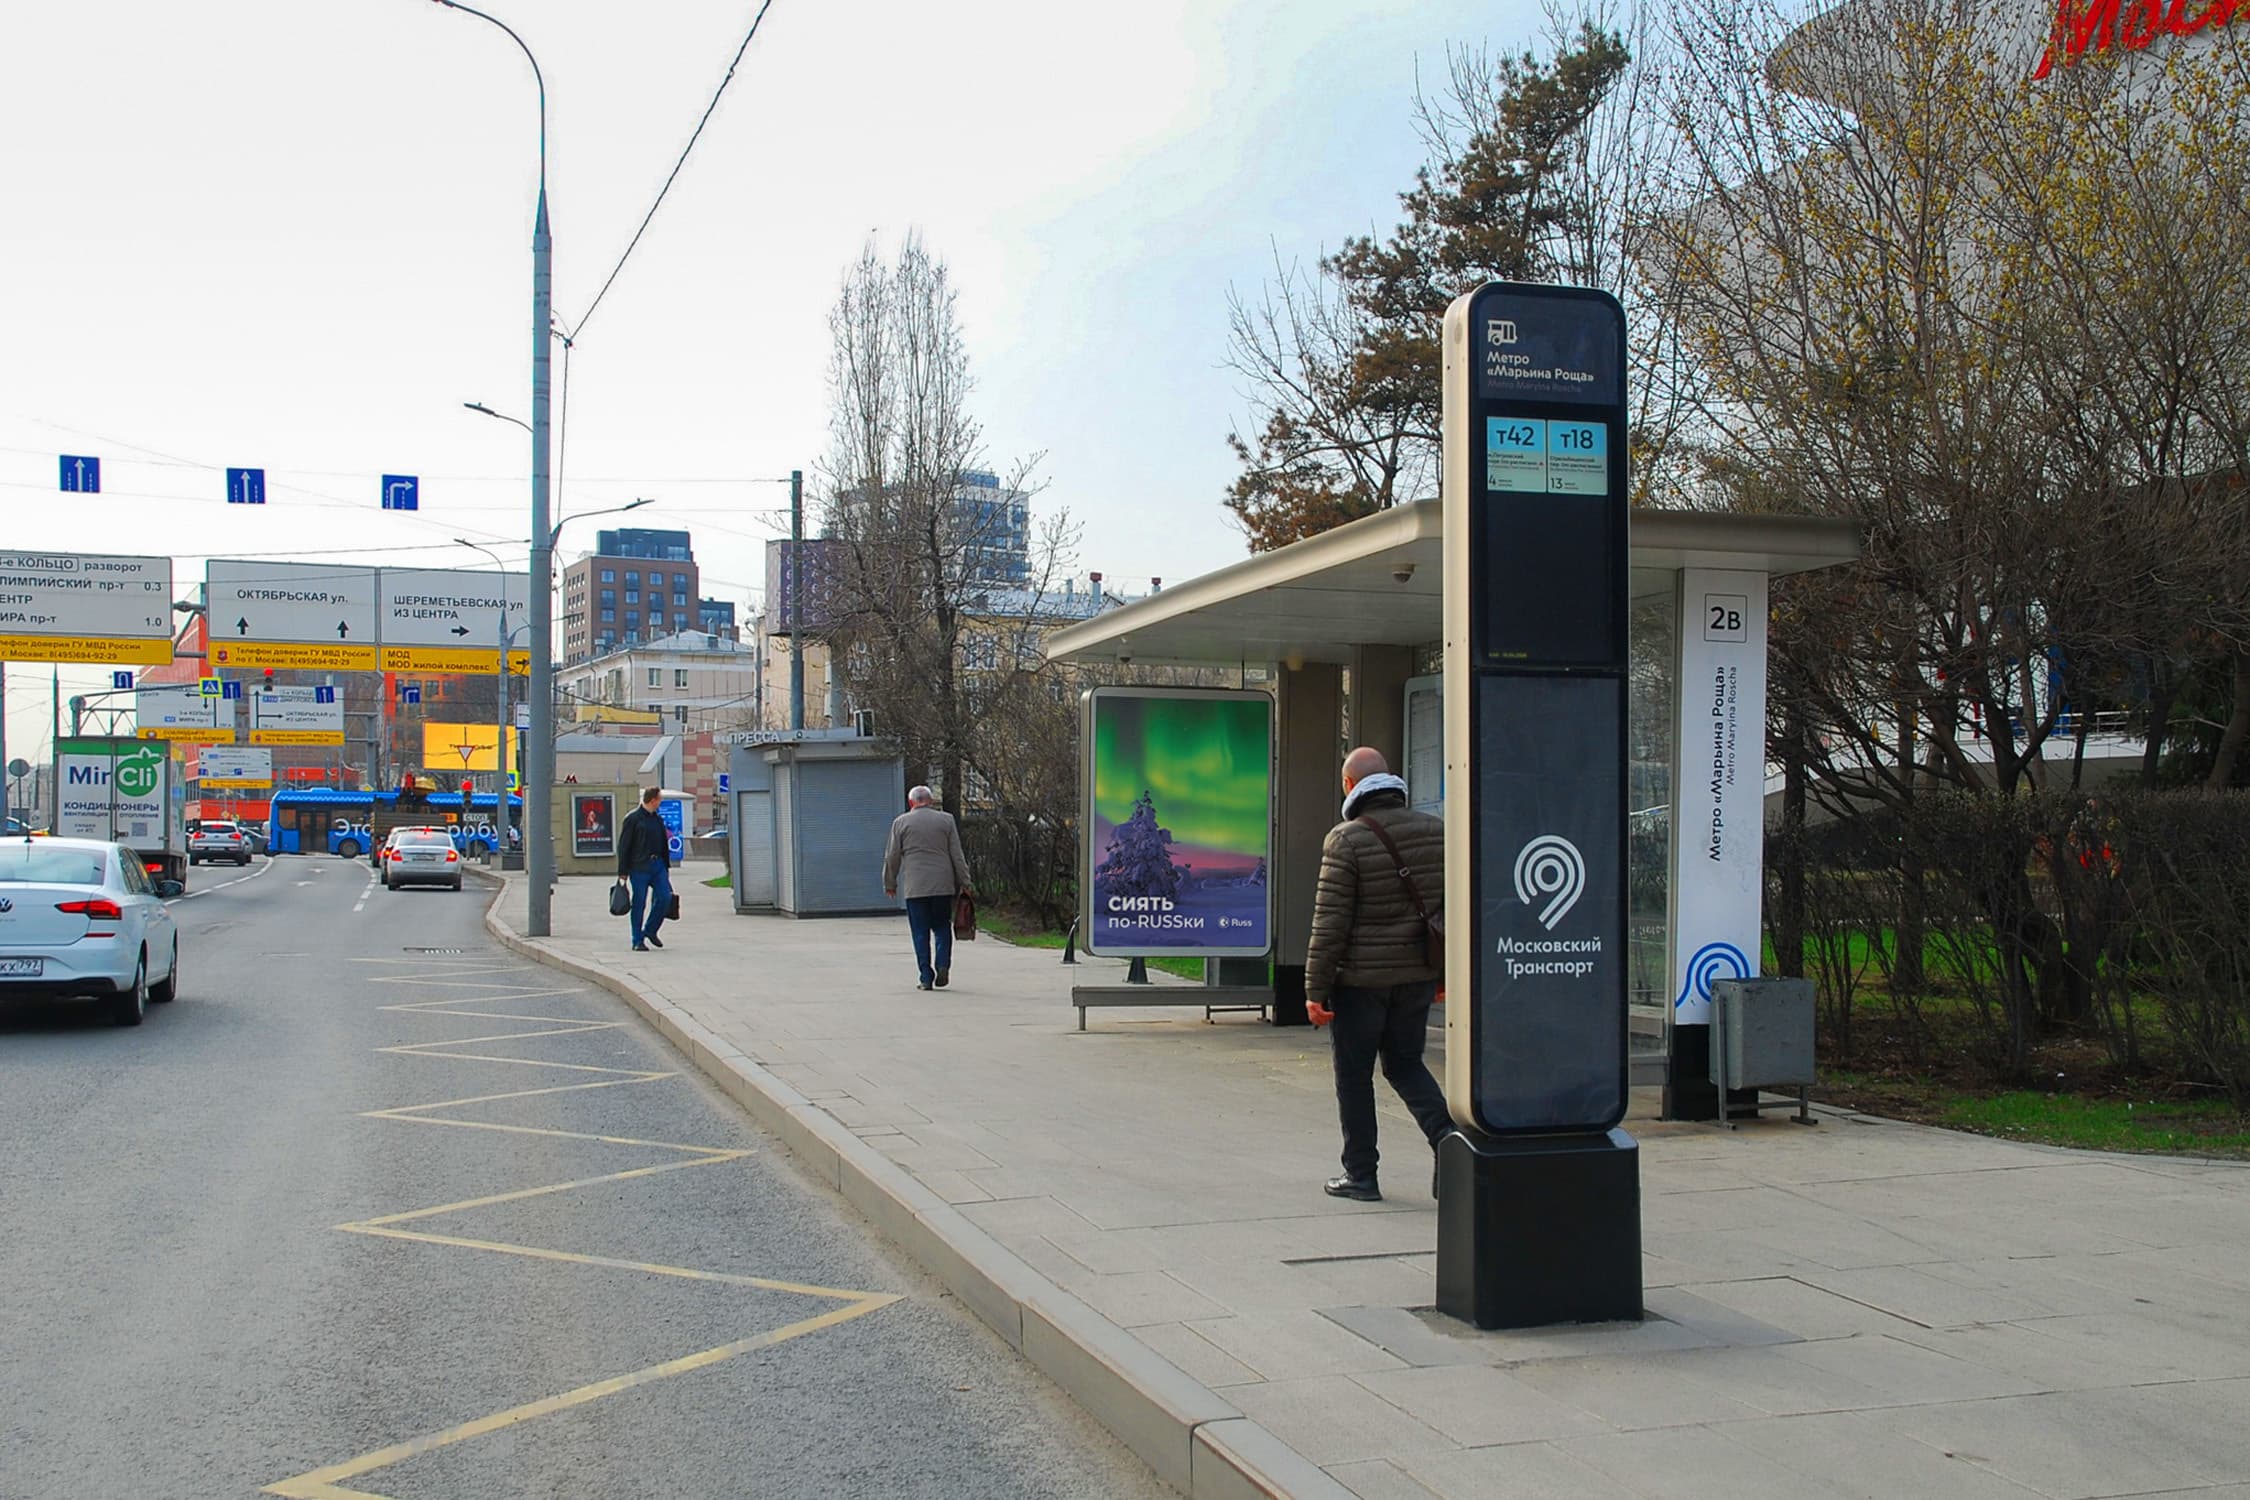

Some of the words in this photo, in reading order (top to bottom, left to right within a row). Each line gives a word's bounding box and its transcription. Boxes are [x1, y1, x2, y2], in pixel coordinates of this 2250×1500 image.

[1487, 351, 1530, 366] Метро
[1487, 364, 1552, 380] «Марьина
[1554, 368, 1594, 383] Роща»
[1488, 475, 1496, 486] 4
[1550, 478, 1563, 489] 13
[18, 557, 74, 571] КОЛЬЦО
[84, 562, 142, 573] разворот
[99, 582, 125, 592] пр-т
[144, 582, 162, 592] 0.3
[237, 589, 328, 602] ОКТЯБРЬСКАЯ
[331, 594, 349, 604] ул.
[394, 595, 507, 609] ШЕРЕМЕТЬЕВСКАЯ
[30, 615, 57, 625] пр-т
[394, 609, 409, 618] ИЗ
[412, 609, 459, 619] ЦЕНТРА
[145, 617, 162, 627] 1.0
[31, 641, 70, 650] доверия
[72, 641, 83, 650] ГУ
[86, 641, 106, 651] МВД
[108, 641, 141, 650] России
[236, 647, 272, 656] Телефон
[273, 648, 308, 657] доверия
[310, 649, 320, 657] ГУ
[322, 649, 341, 658] МВД
[342, 650, 371, 658] России
[10, 649, 46, 658] Москве:
[387, 650, 411, 659] МОД
[412, 661, 443, 671] жилой
[445, 663, 490, 671] комплекс
[1712, 665, 1726, 717] Роща»
[1727, 666, 1737, 704] Roscha
[1727, 706, 1737, 751] Maryina
[729, 730, 780, 745] ПРЕССА
[1710, 721, 1725, 804] «Марьина
[1726, 752, 1736, 785] Metro
[69, 766, 112, 785] Mir
[118, 767, 153, 787] Cli
[64, 802, 160, 812] КОНДИЦИОНЕРЫ
[1709, 807, 1724, 862] Метро
[1108, 914, 1205, 929] по-RUSSки
[1231, 918, 1253, 927] Russ
[1497, 936, 1601, 953] Московский
[1505, 958, 1594, 980] Транспорт
